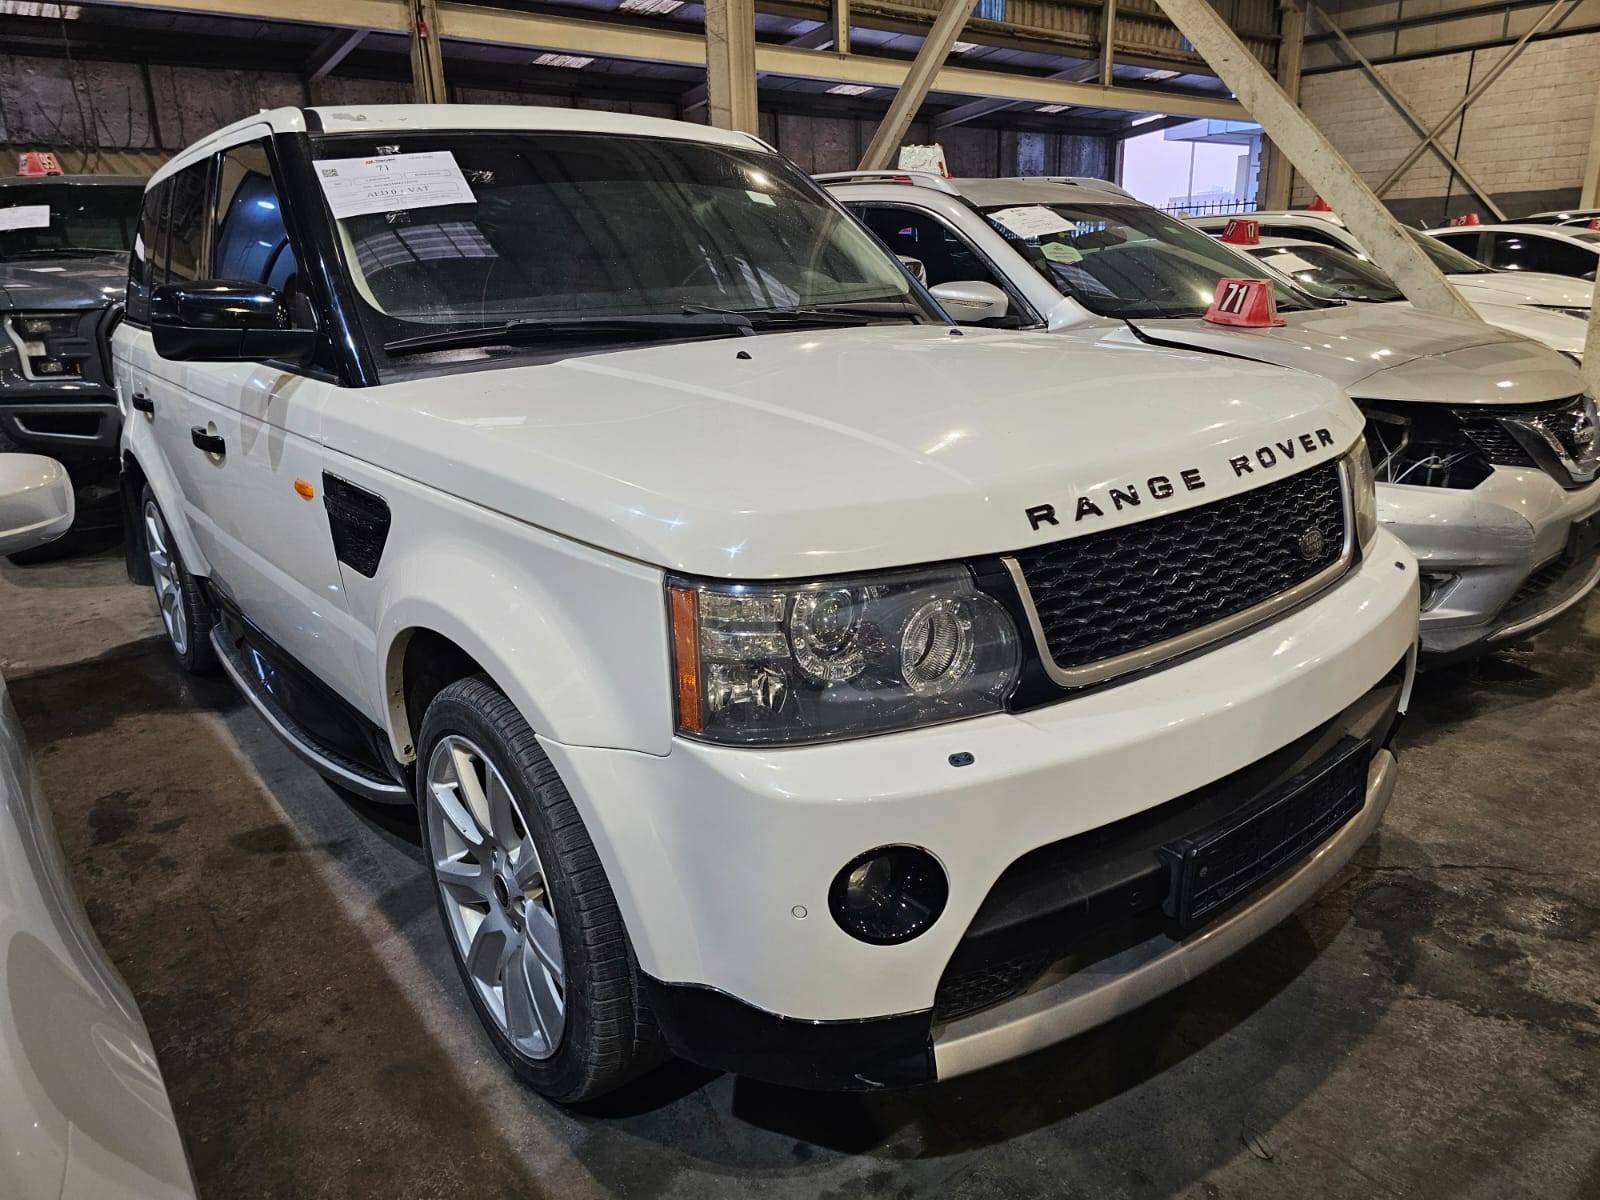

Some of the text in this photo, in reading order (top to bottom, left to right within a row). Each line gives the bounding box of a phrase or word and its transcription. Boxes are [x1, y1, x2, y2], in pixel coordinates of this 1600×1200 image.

[407, 184, 431, 193] VAT
[1219, 283, 1249, 314] 71
[1025, 427, 1335, 531] RANGE ROVER
